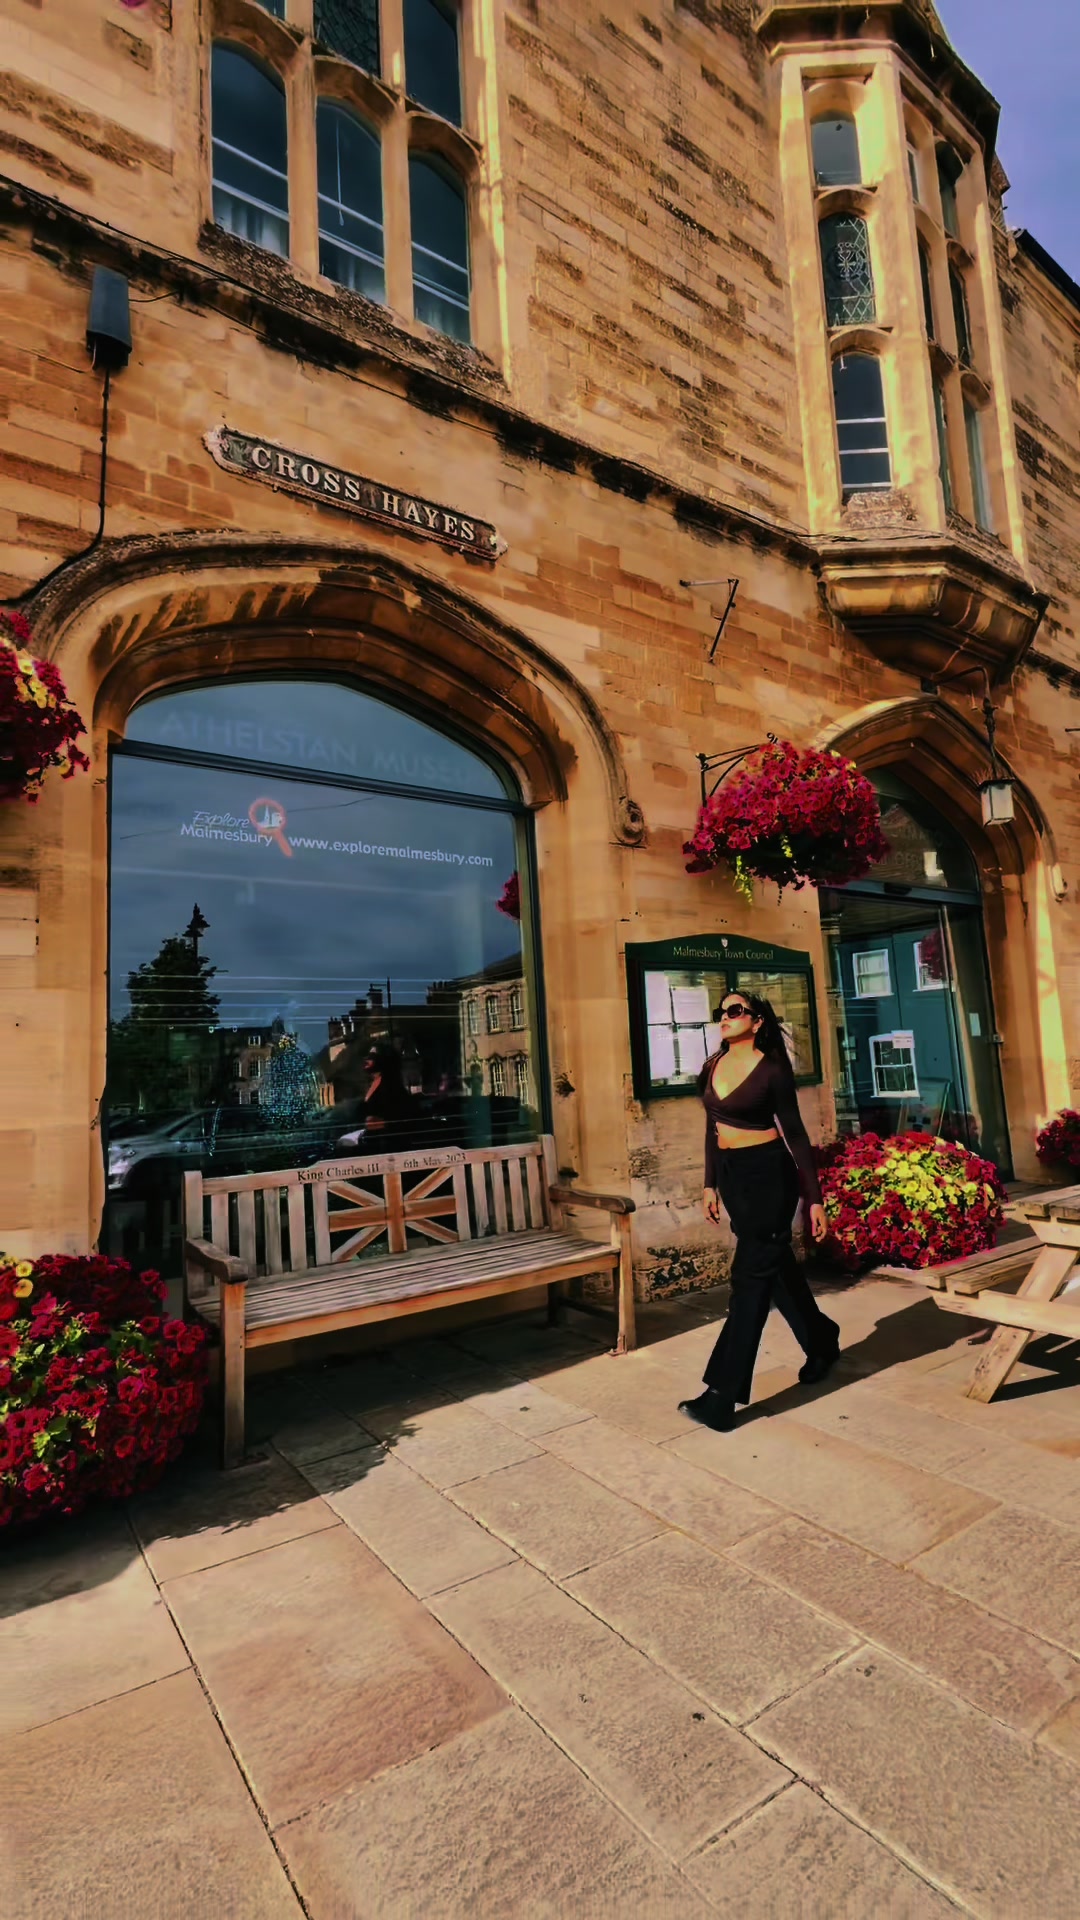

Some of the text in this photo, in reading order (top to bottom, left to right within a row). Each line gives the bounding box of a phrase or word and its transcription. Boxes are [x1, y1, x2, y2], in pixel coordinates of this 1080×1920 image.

[252, 447, 475, 542] CROSS HAYES
[159, 710, 358, 769] ATHELSTAN
[193, 810, 250, 829] Explore
[180, 823, 273, 847] Malmesbury
[288, 835, 494, 868] www.exploremalmesbury.com
[673, 945, 774, 961] Malmesbury Town Council
[297, 1152, 466, 1182] King Charles III 6th May 2023
